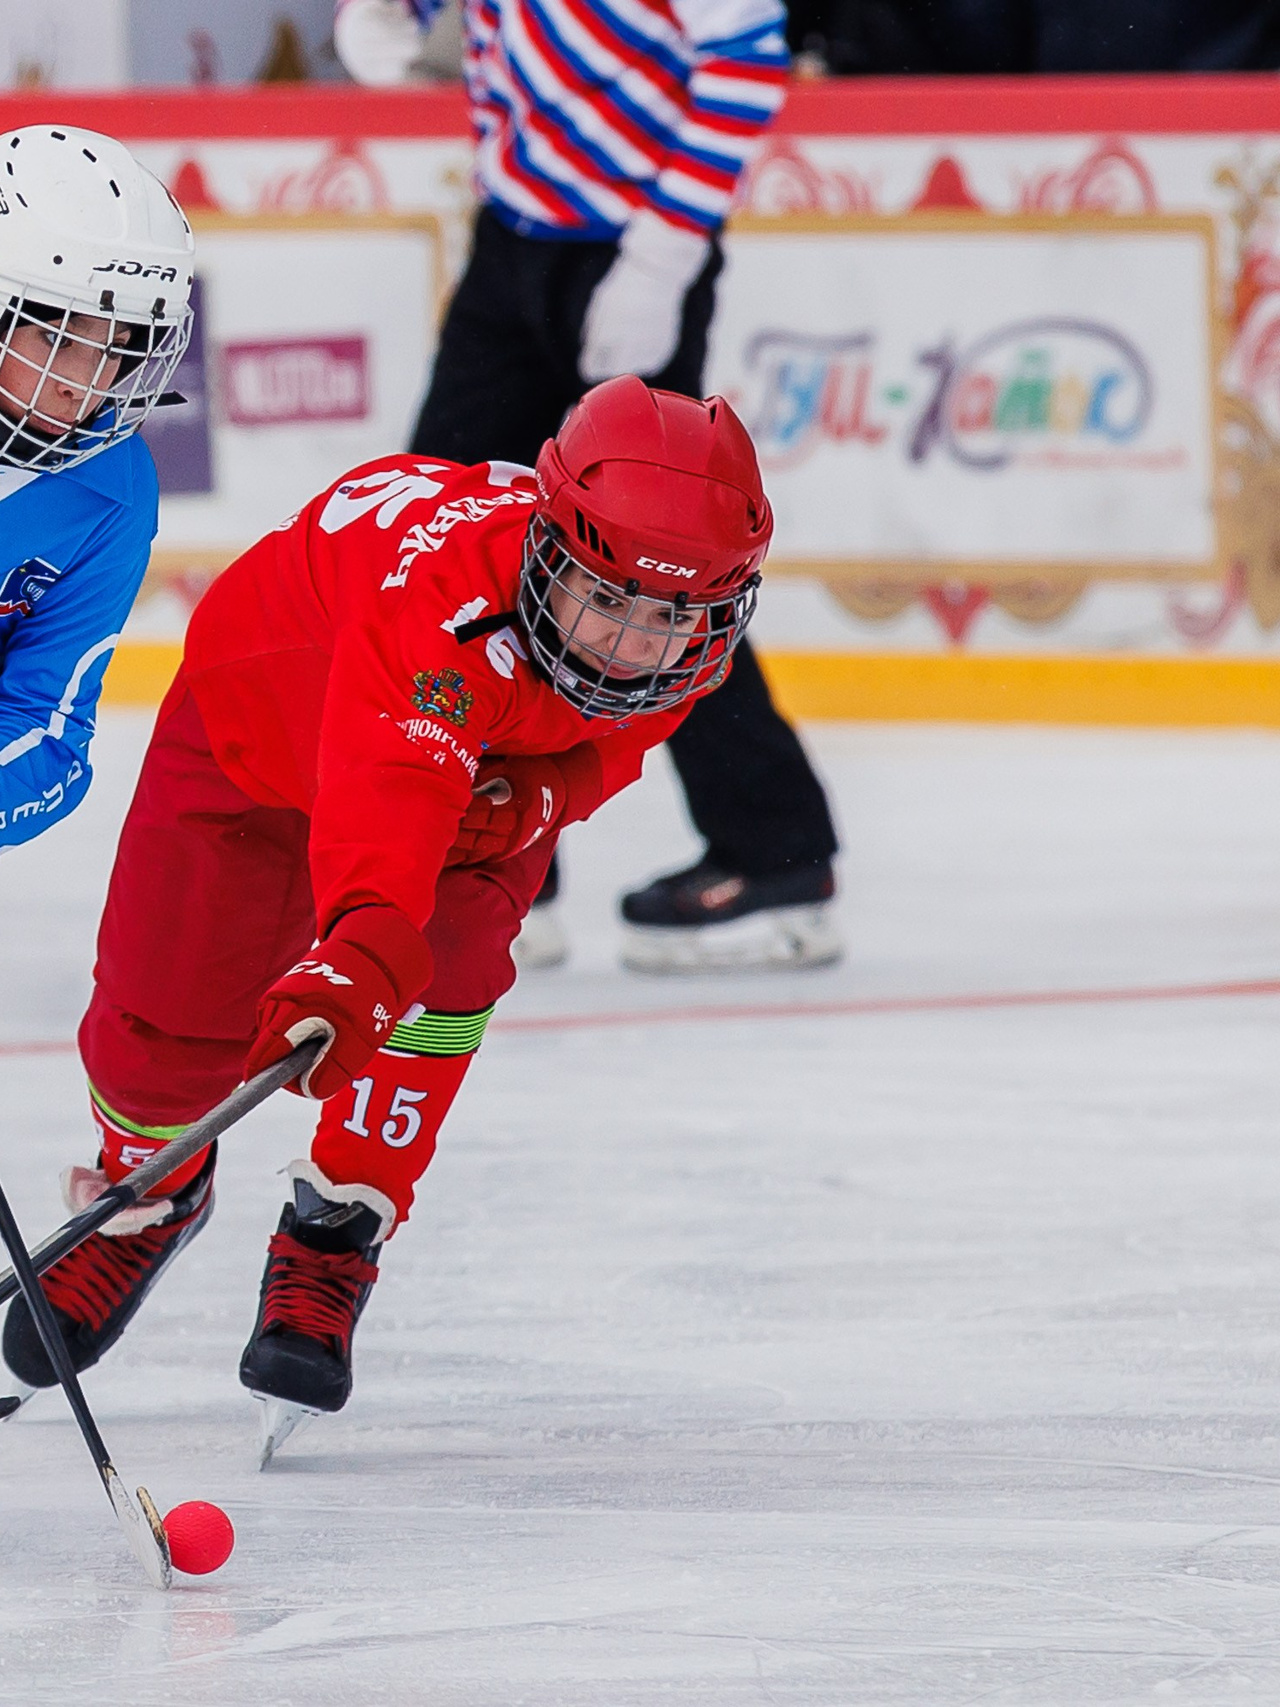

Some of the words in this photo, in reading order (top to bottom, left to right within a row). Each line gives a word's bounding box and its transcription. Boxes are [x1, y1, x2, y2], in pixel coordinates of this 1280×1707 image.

[93, 258, 177, 283] JOFA
[635, 556, 698, 579] CCM
[343, 1076, 428, 1148] 15
